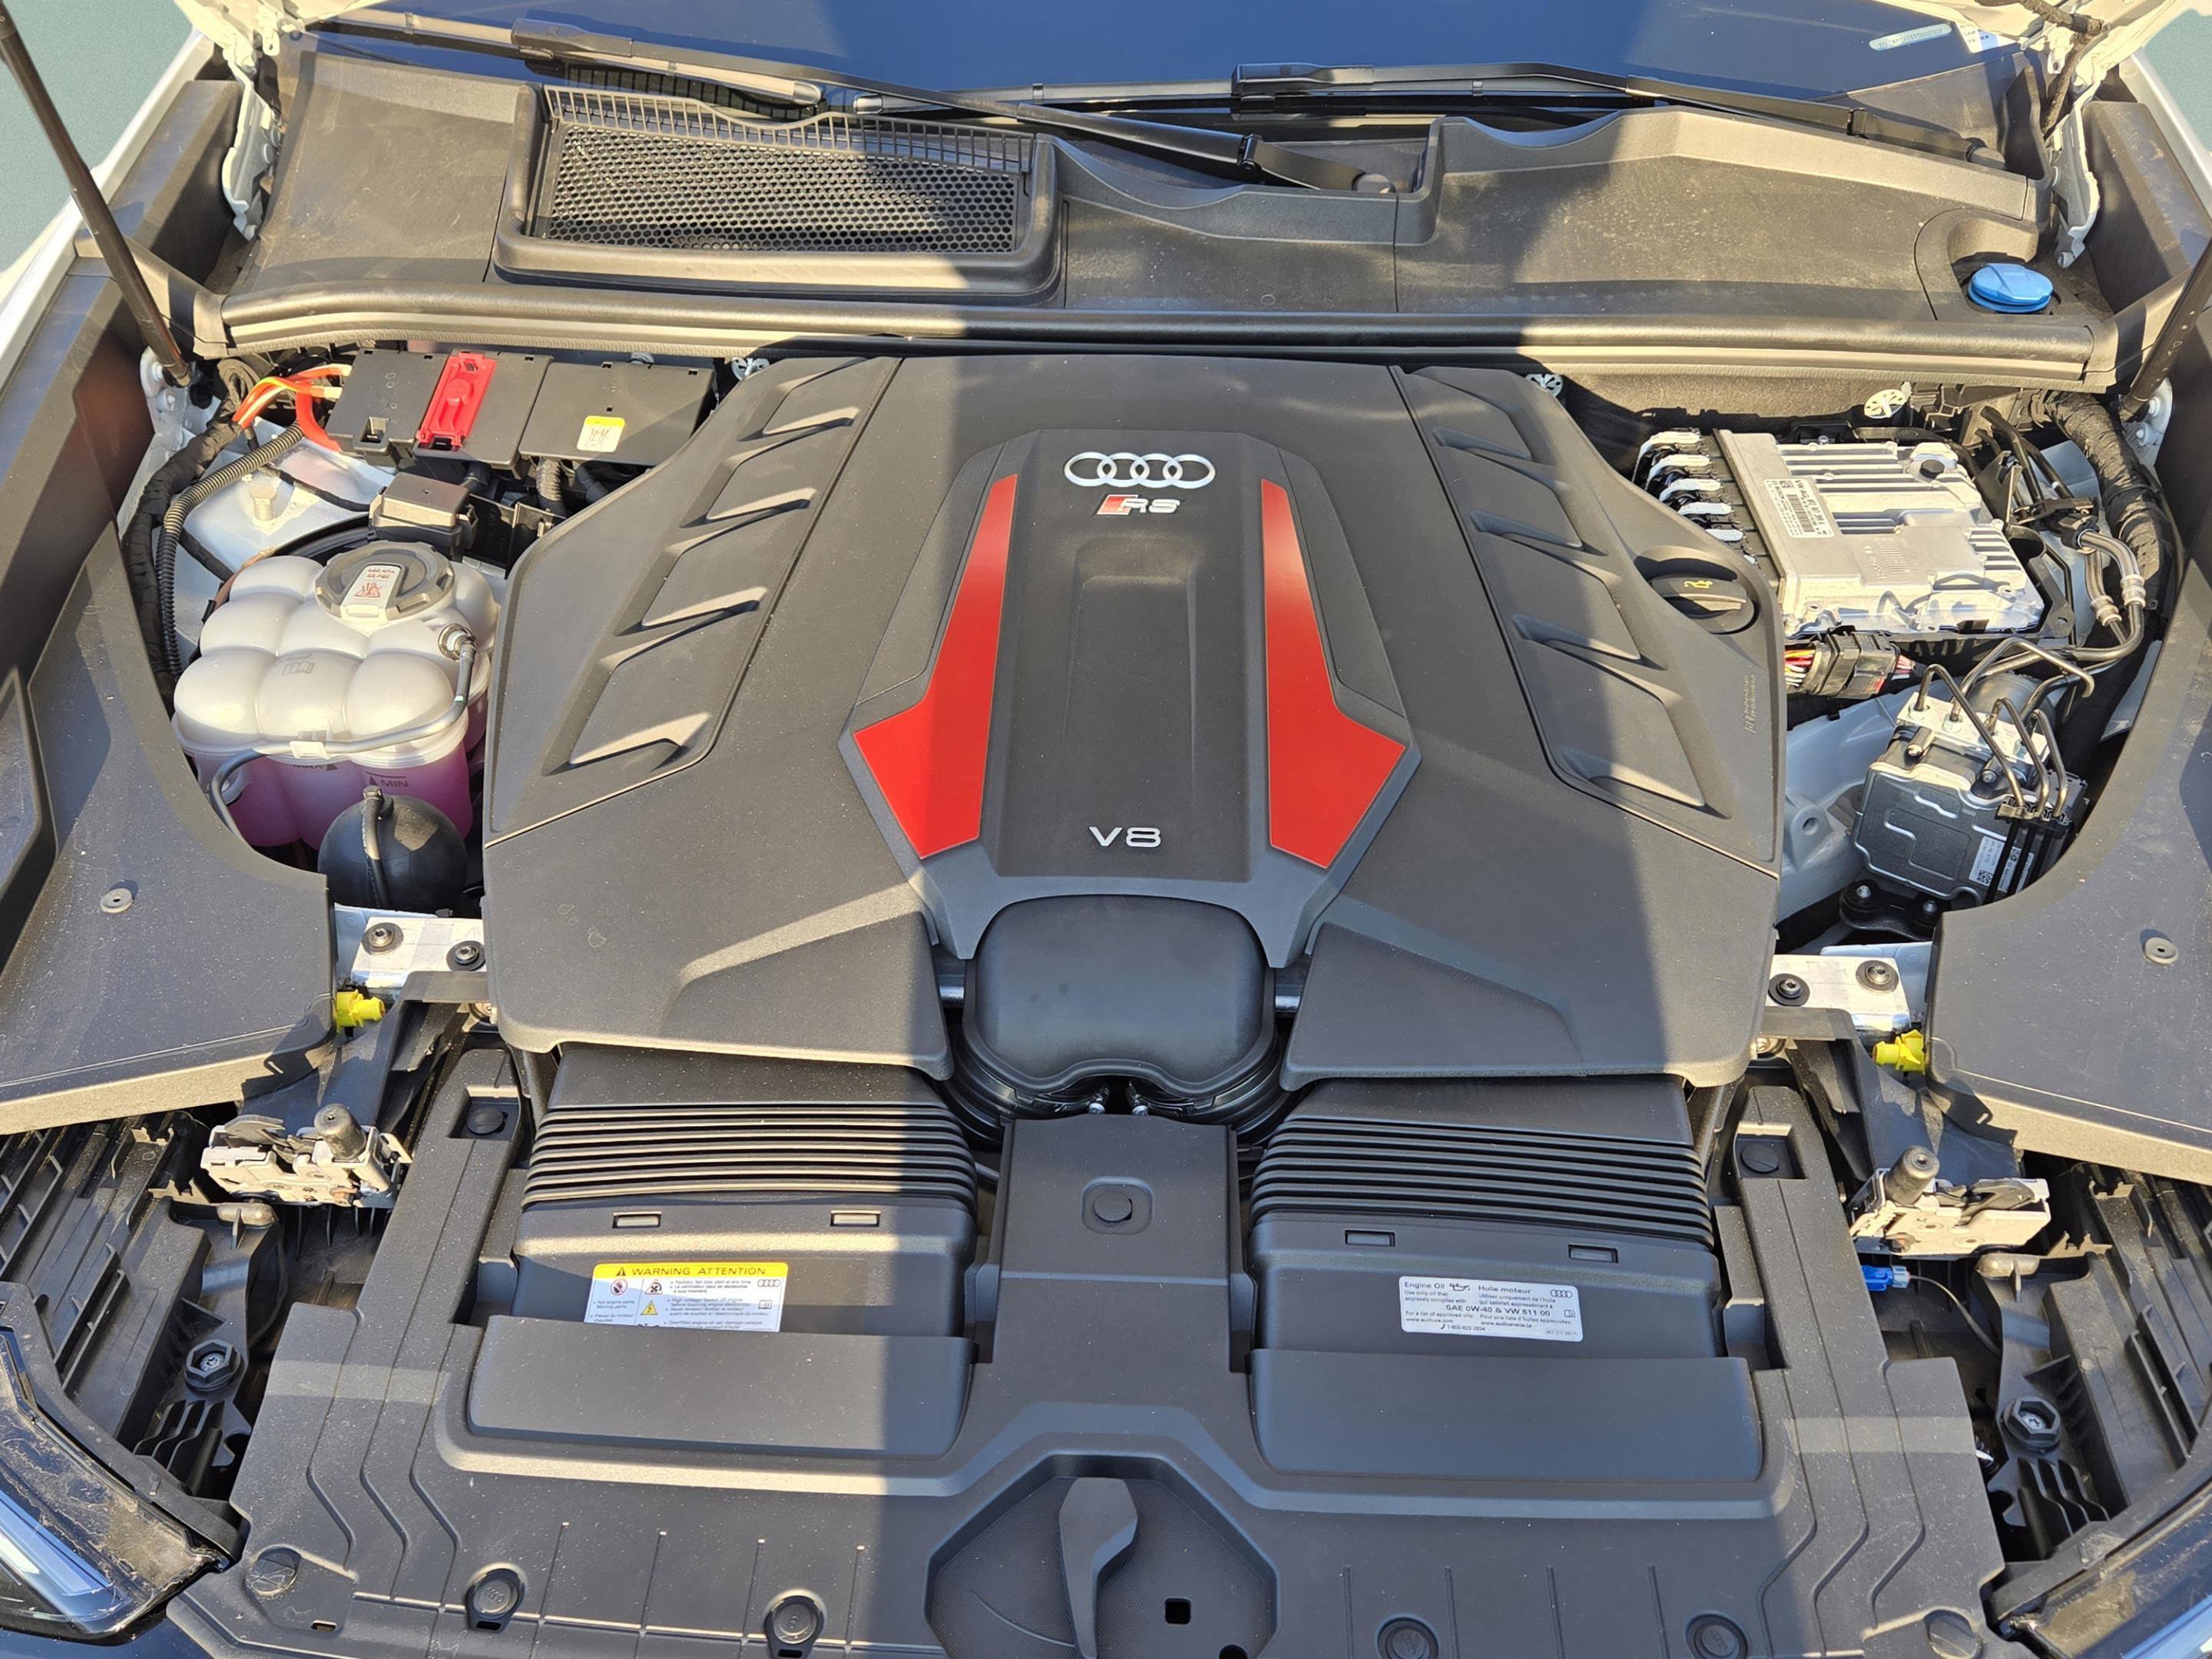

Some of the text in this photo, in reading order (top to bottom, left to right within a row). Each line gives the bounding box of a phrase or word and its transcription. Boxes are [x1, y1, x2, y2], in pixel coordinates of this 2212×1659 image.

[1115, 496, 1181, 514] RS
[1089, 826, 1162, 848] V8
[632, 1267, 766, 1276] WARNING ATTENTION
